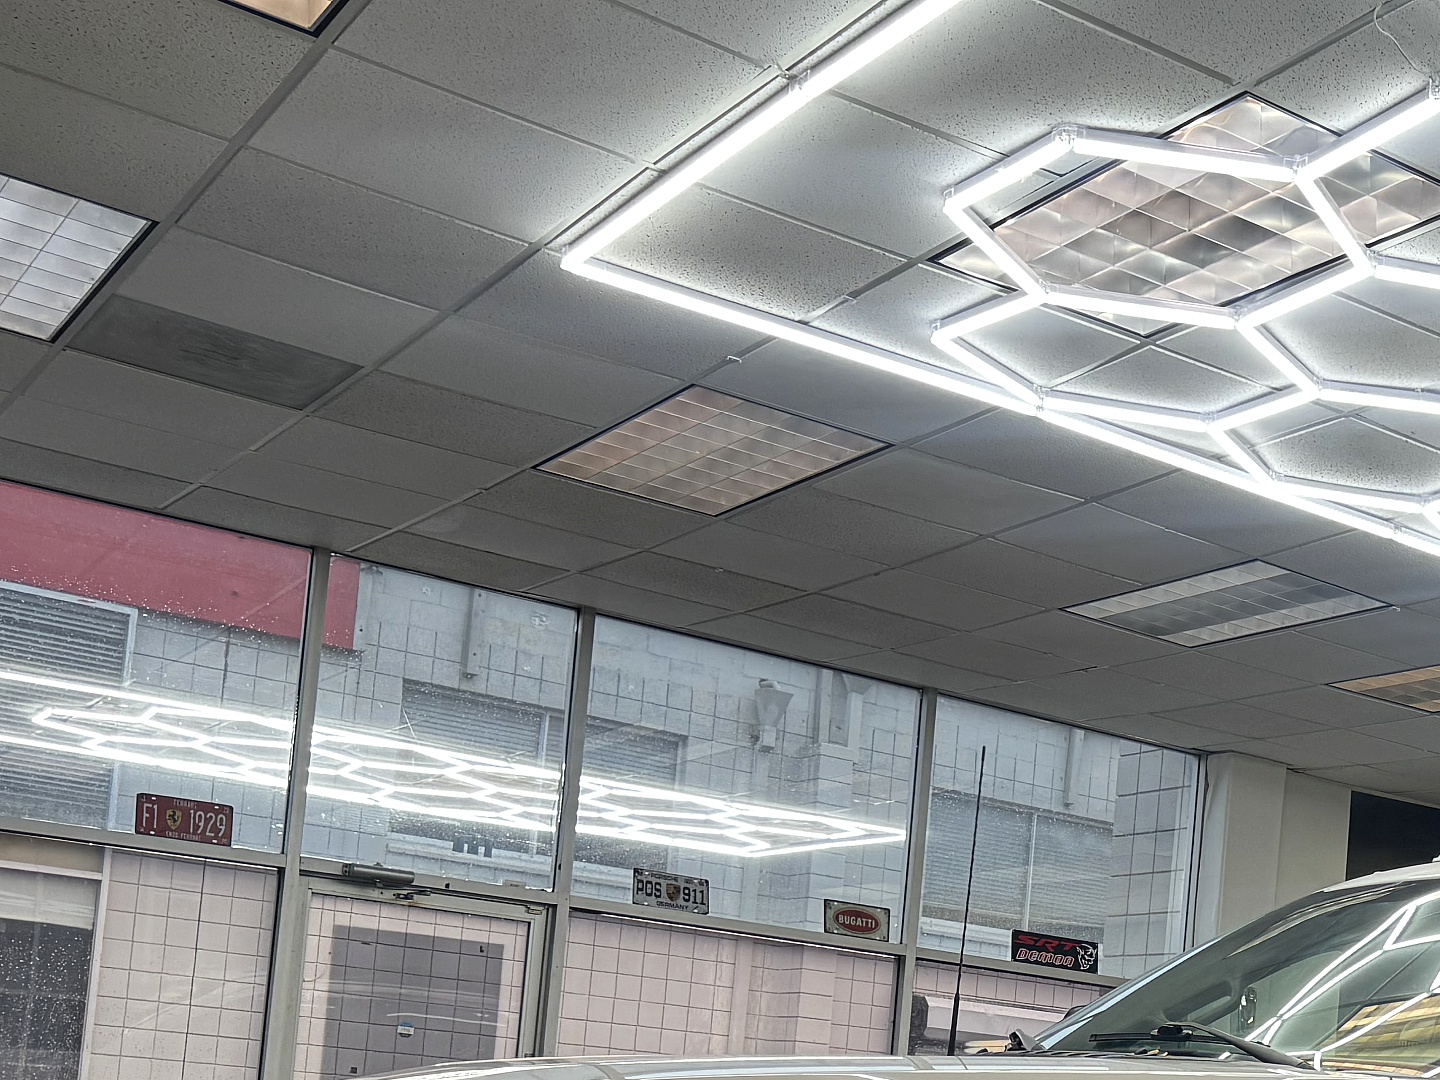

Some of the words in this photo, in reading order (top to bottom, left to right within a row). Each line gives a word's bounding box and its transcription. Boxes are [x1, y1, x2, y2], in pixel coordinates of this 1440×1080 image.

[143, 803, 158, 829] F1
[189, 809, 226, 837] 1929
[636, 878, 662, 898] POS
[682, 886, 706, 905] 911
[656, 901, 689, 910] GERMANY
[838, 914, 875, 929] BUGATTI
[1014, 935, 1082, 952] SRT
[1016, 948, 1075, 967] DEMON
